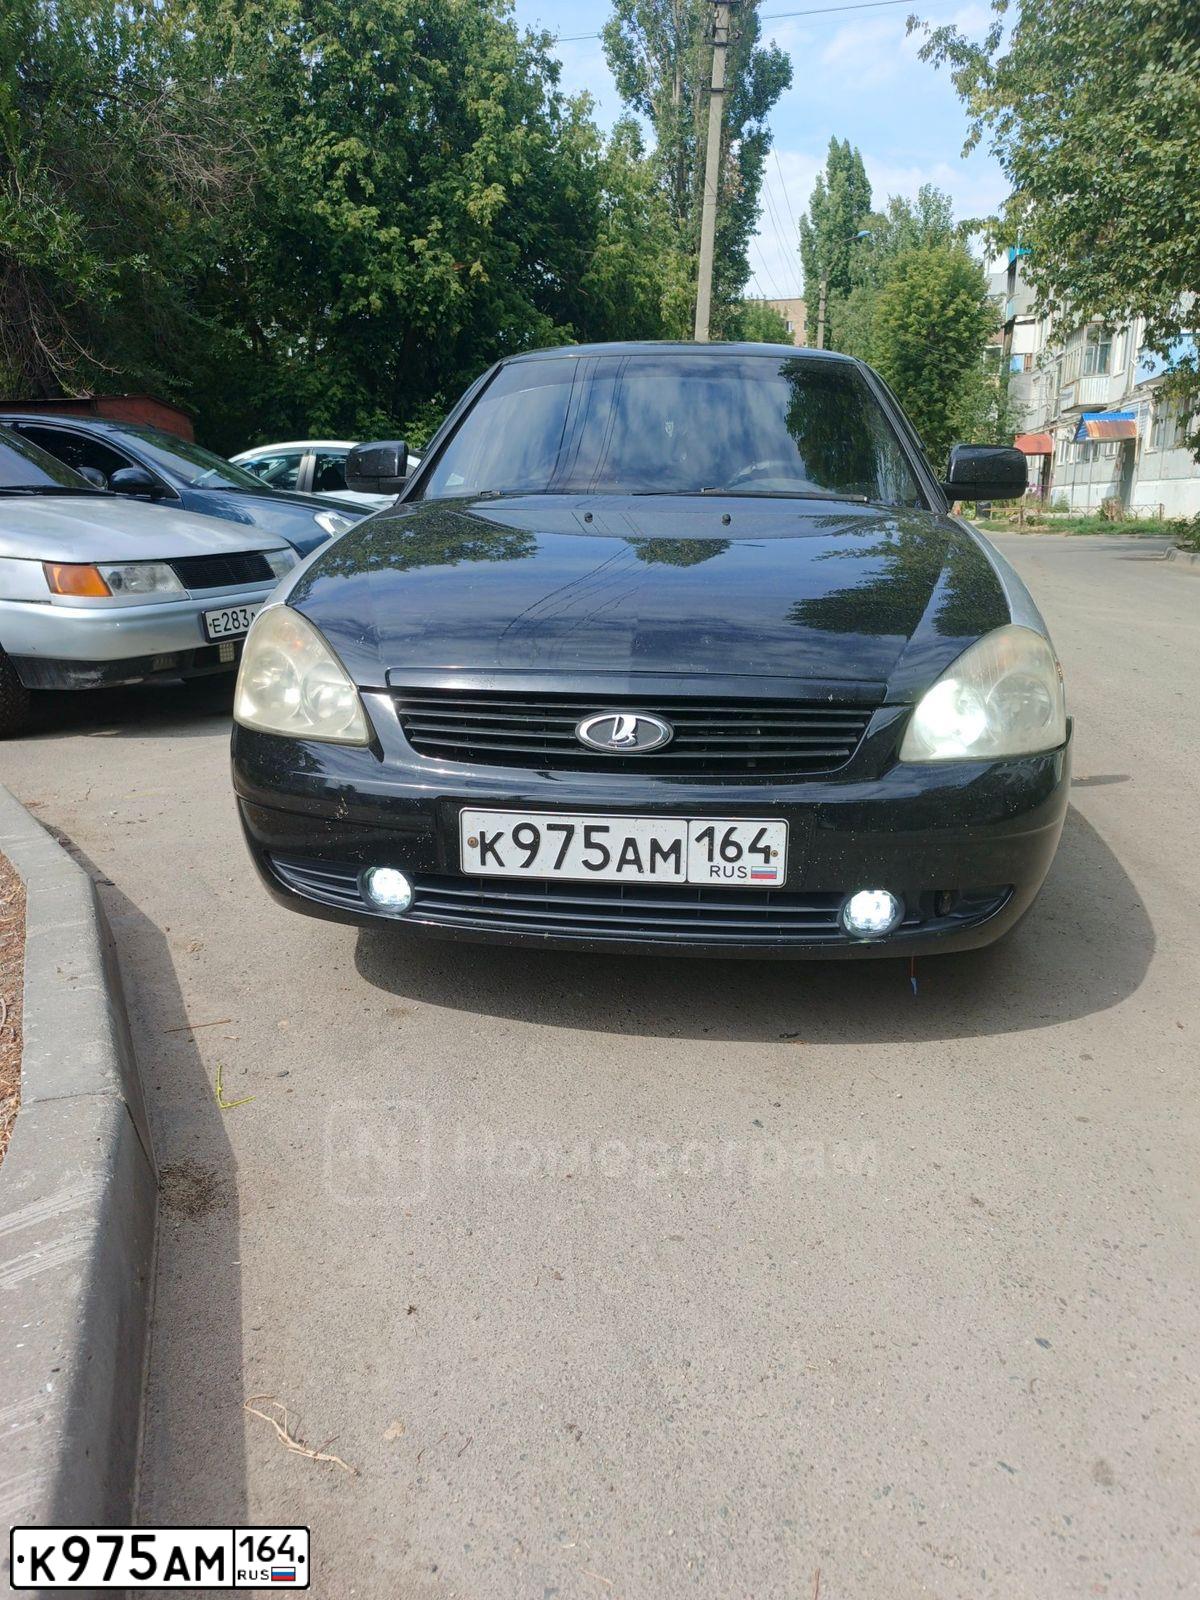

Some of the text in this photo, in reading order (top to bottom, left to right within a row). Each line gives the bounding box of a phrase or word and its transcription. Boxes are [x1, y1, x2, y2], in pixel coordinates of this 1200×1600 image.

[478, 821, 772, 875] К975АМ 164
[709, 865, 748, 879] RUS
